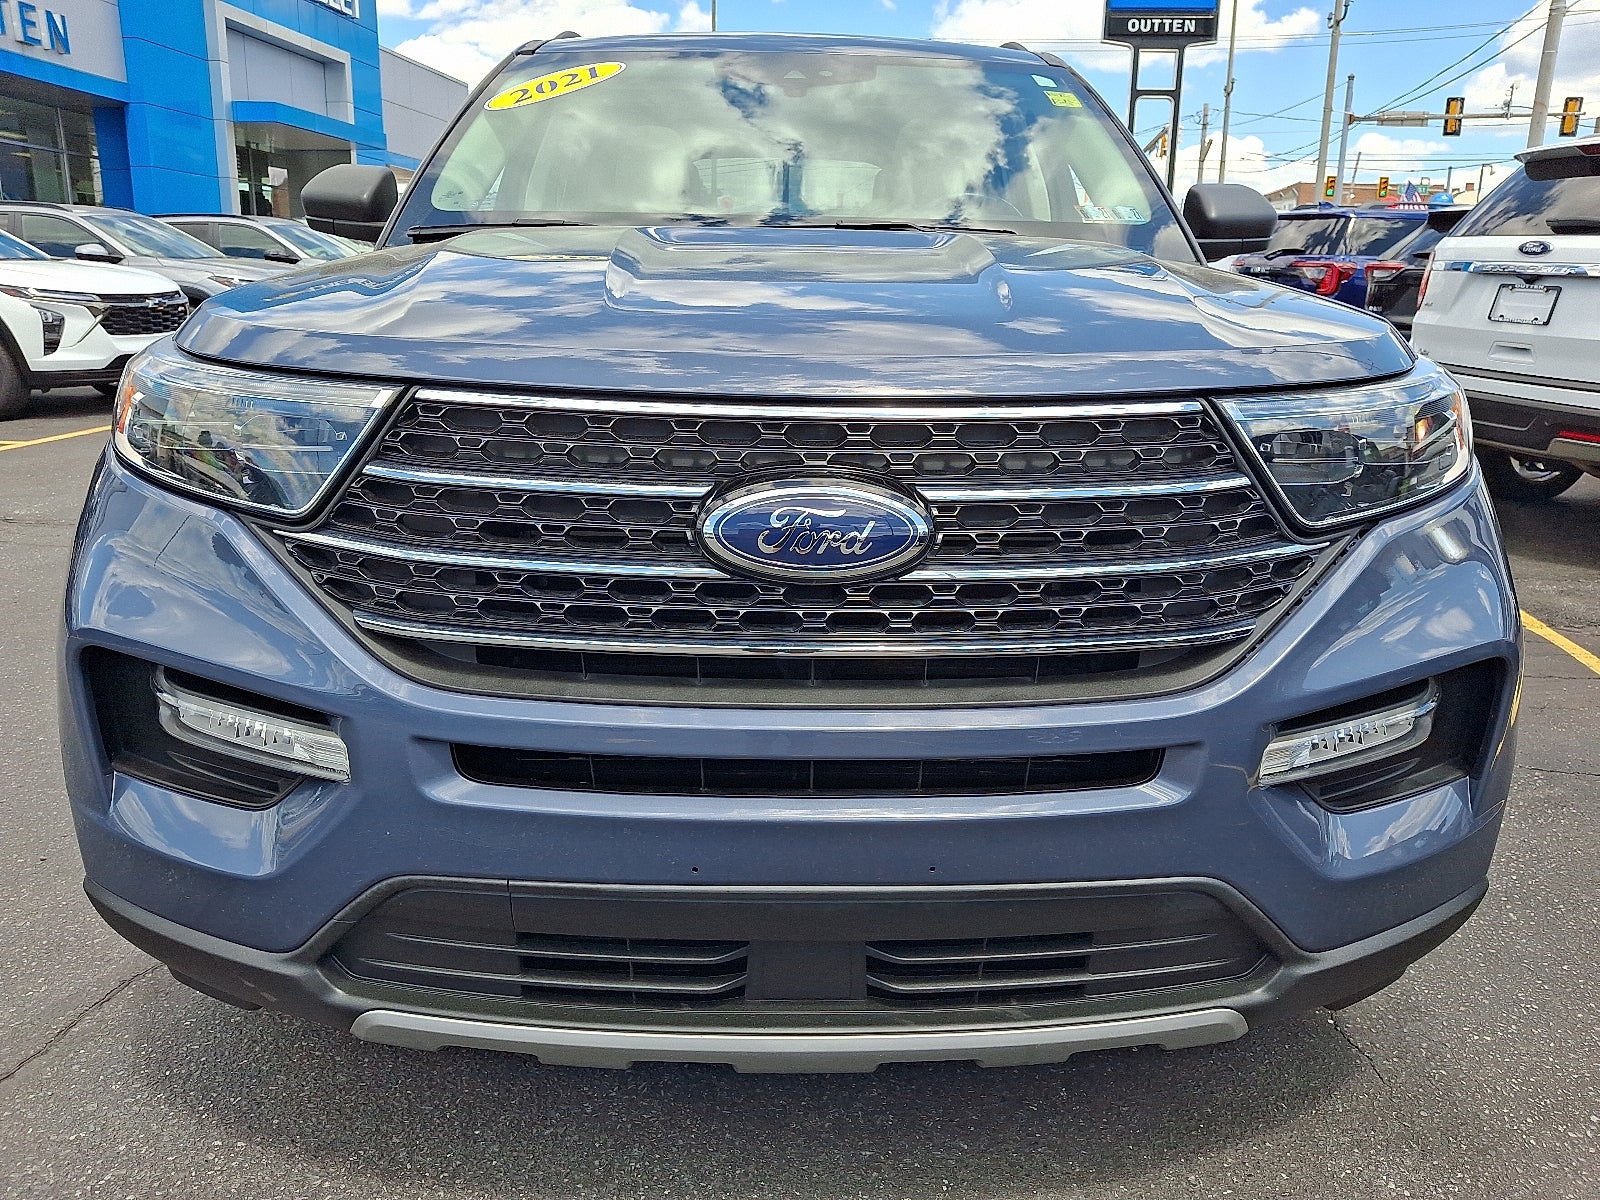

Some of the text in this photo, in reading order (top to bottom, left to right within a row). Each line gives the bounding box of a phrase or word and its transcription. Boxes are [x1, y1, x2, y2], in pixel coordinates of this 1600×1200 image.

[1127, 18, 1196, 33] OUTTEN
[509, 66, 600, 105] 2021
[1521, 241, 1544, 253] Ford
[756, 506, 876, 555] Ford
